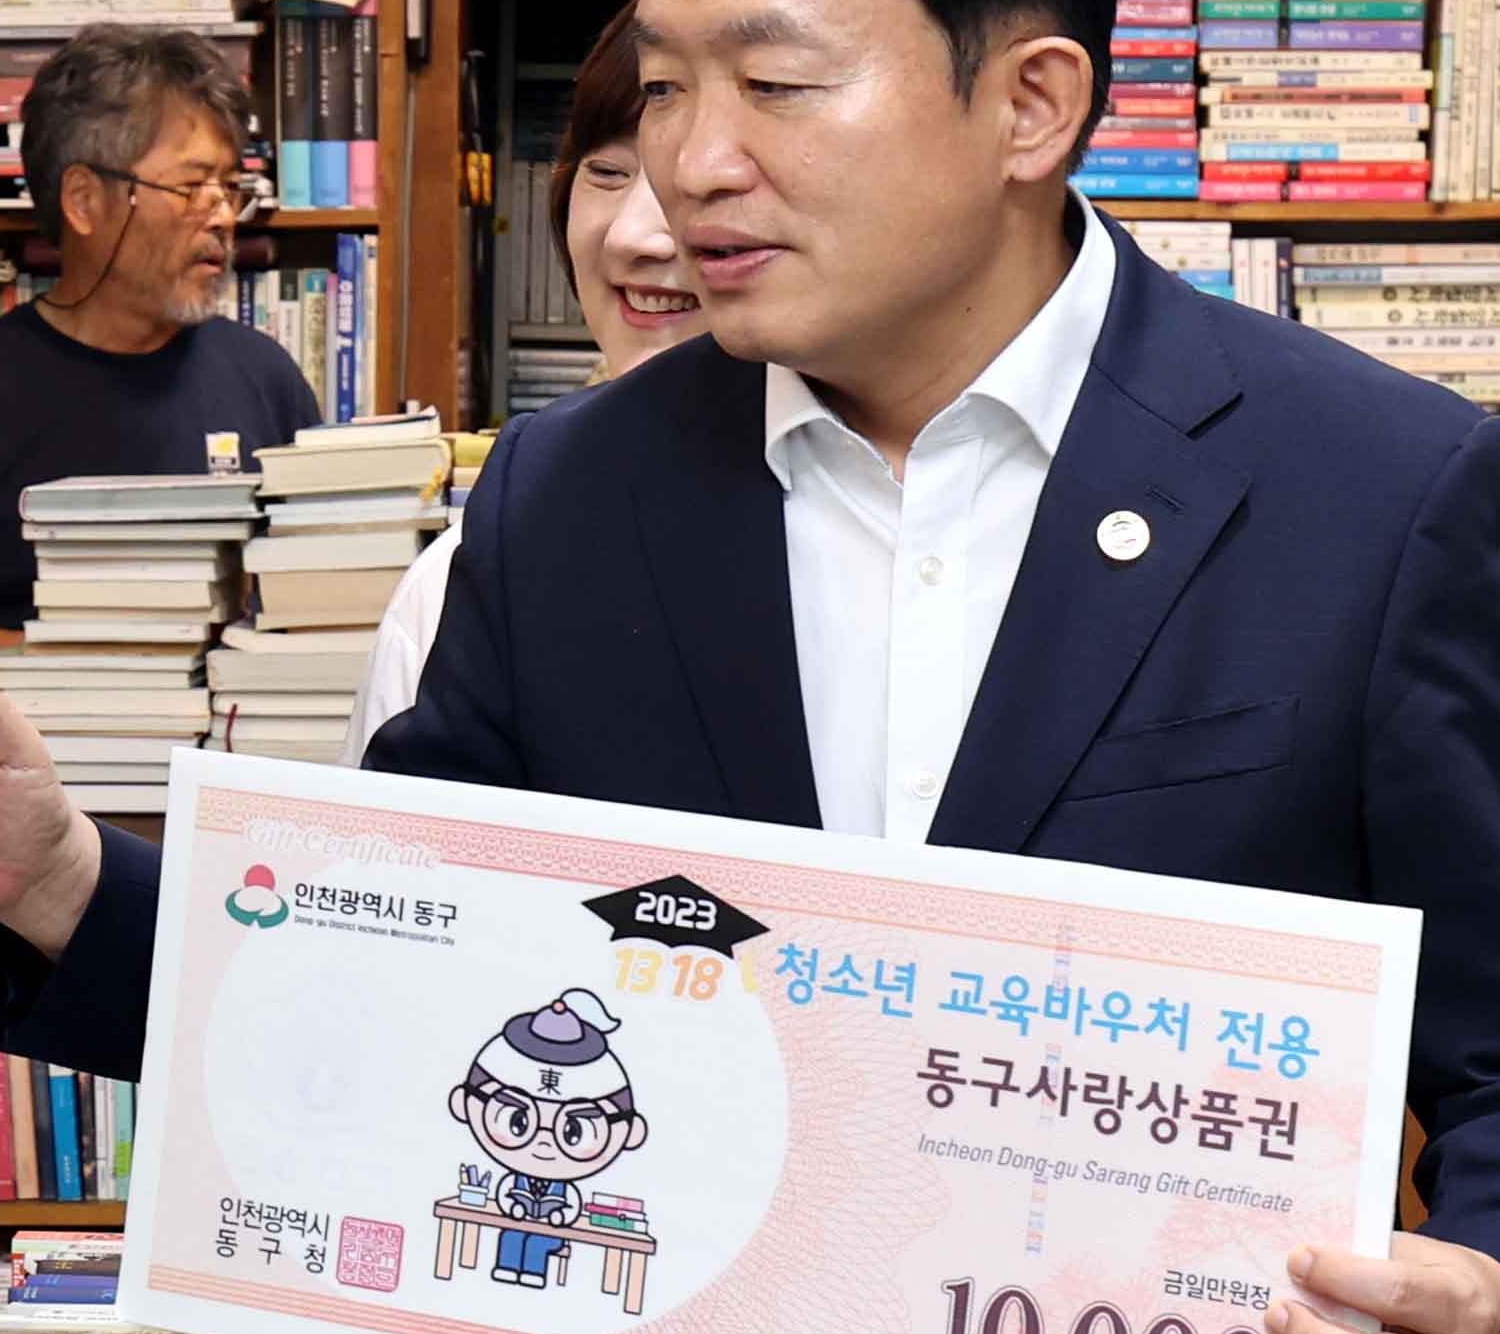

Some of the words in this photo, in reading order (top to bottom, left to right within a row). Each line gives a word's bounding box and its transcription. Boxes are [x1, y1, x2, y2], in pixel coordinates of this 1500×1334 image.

[303, 828, 442, 871] Certificate
[294, 883, 405, 922] 인천광역시
[413, 901, 458, 929] 동구
[634, 891, 718, 931] 2023
[614, 947, 659, 993] 13
[671, 954, 724, 1001] 18
[775, 942, 918, 1019] 청소년
[938, 970, 1191, 1049] 교육바우처
[1216, 1007, 1321, 1080] 전용
[536, 1068, 564, 1096] 東
[916, 1047, 1300, 1162] 동구사랑상품권
[916, 1133, 994, 1167] Incheon
[995, 1146, 1078, 1181] Dong-gu
[1082, 1160, 1150, 1193] Sarang
[1154, 1171, 1190, 1198] Gift
[1193, 1176, 1293, 1215] Certificate
[219, 1196, 331, 1241] 인천광역시
[1161, 1269, 1272, 1311] 금일만원정
